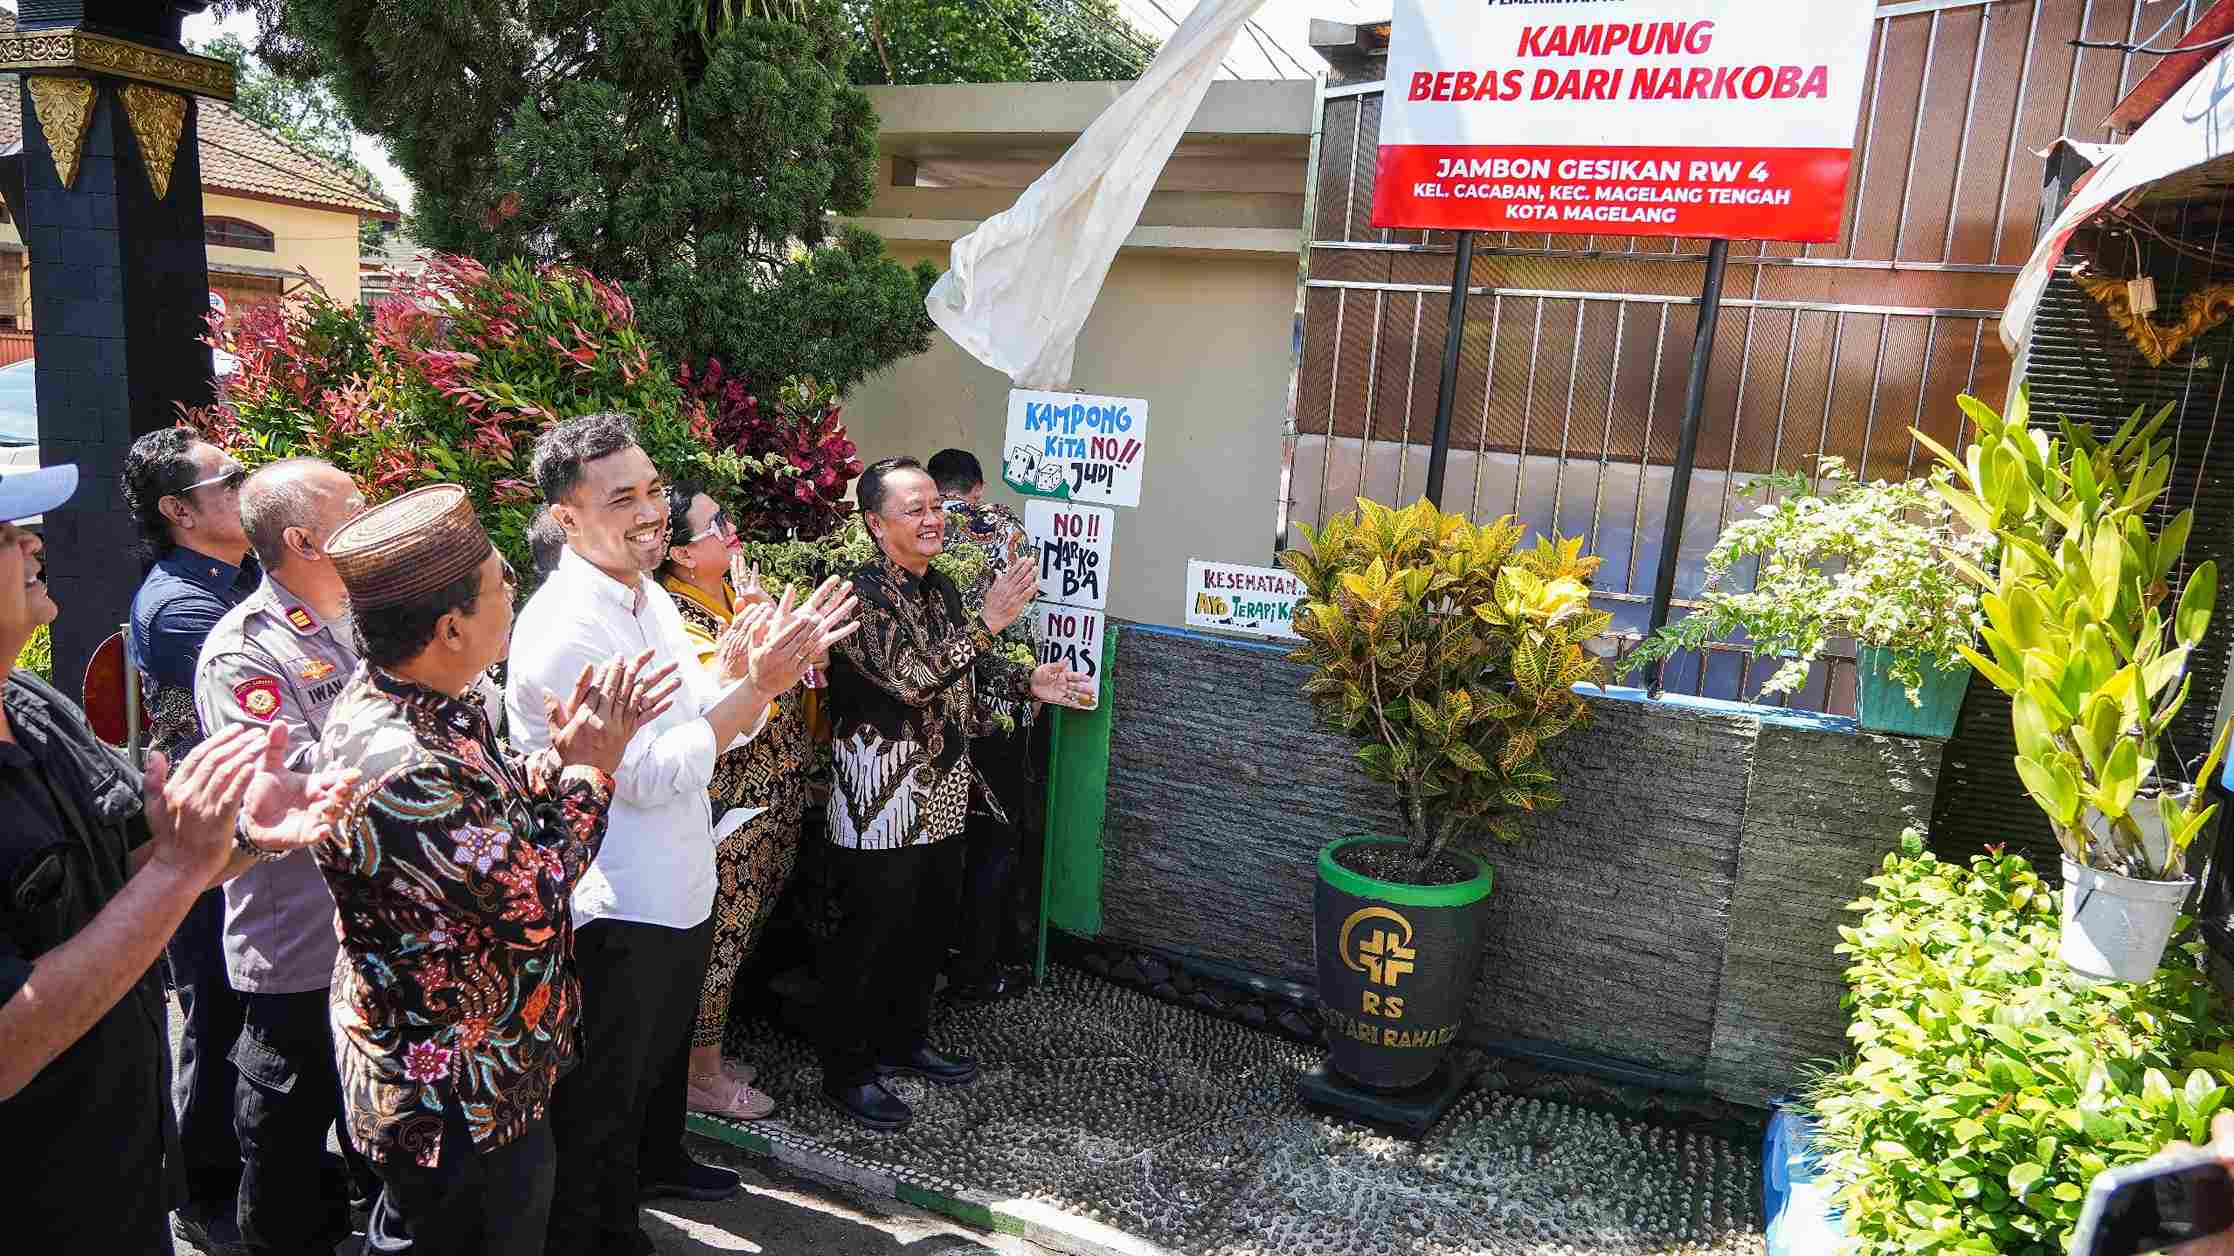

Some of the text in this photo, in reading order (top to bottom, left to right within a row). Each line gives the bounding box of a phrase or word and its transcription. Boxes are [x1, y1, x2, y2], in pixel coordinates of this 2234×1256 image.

[1516, 20, 1714, 57] KAMPUNG
[1407, 65, 1829, 101] BEBAS DARI NARKOBA
[1436, 158, 1769, 183] JAMBON GESIKAN RW 4
[1413, 183, 1792, 205] KEL. CACABAN, KEC. MAGELANG TENGAH
[1505, 204, 1677, 223] KOTA MAGELANG
[1024, 402, 1132, 434] KAMPONG
[1042, 537, 1099, 580] NARKO
[1062, 569, 1099, 600] BA
[308, 679, 344, 705] IWAN
[1362, 989, 1405, 1019] RS
